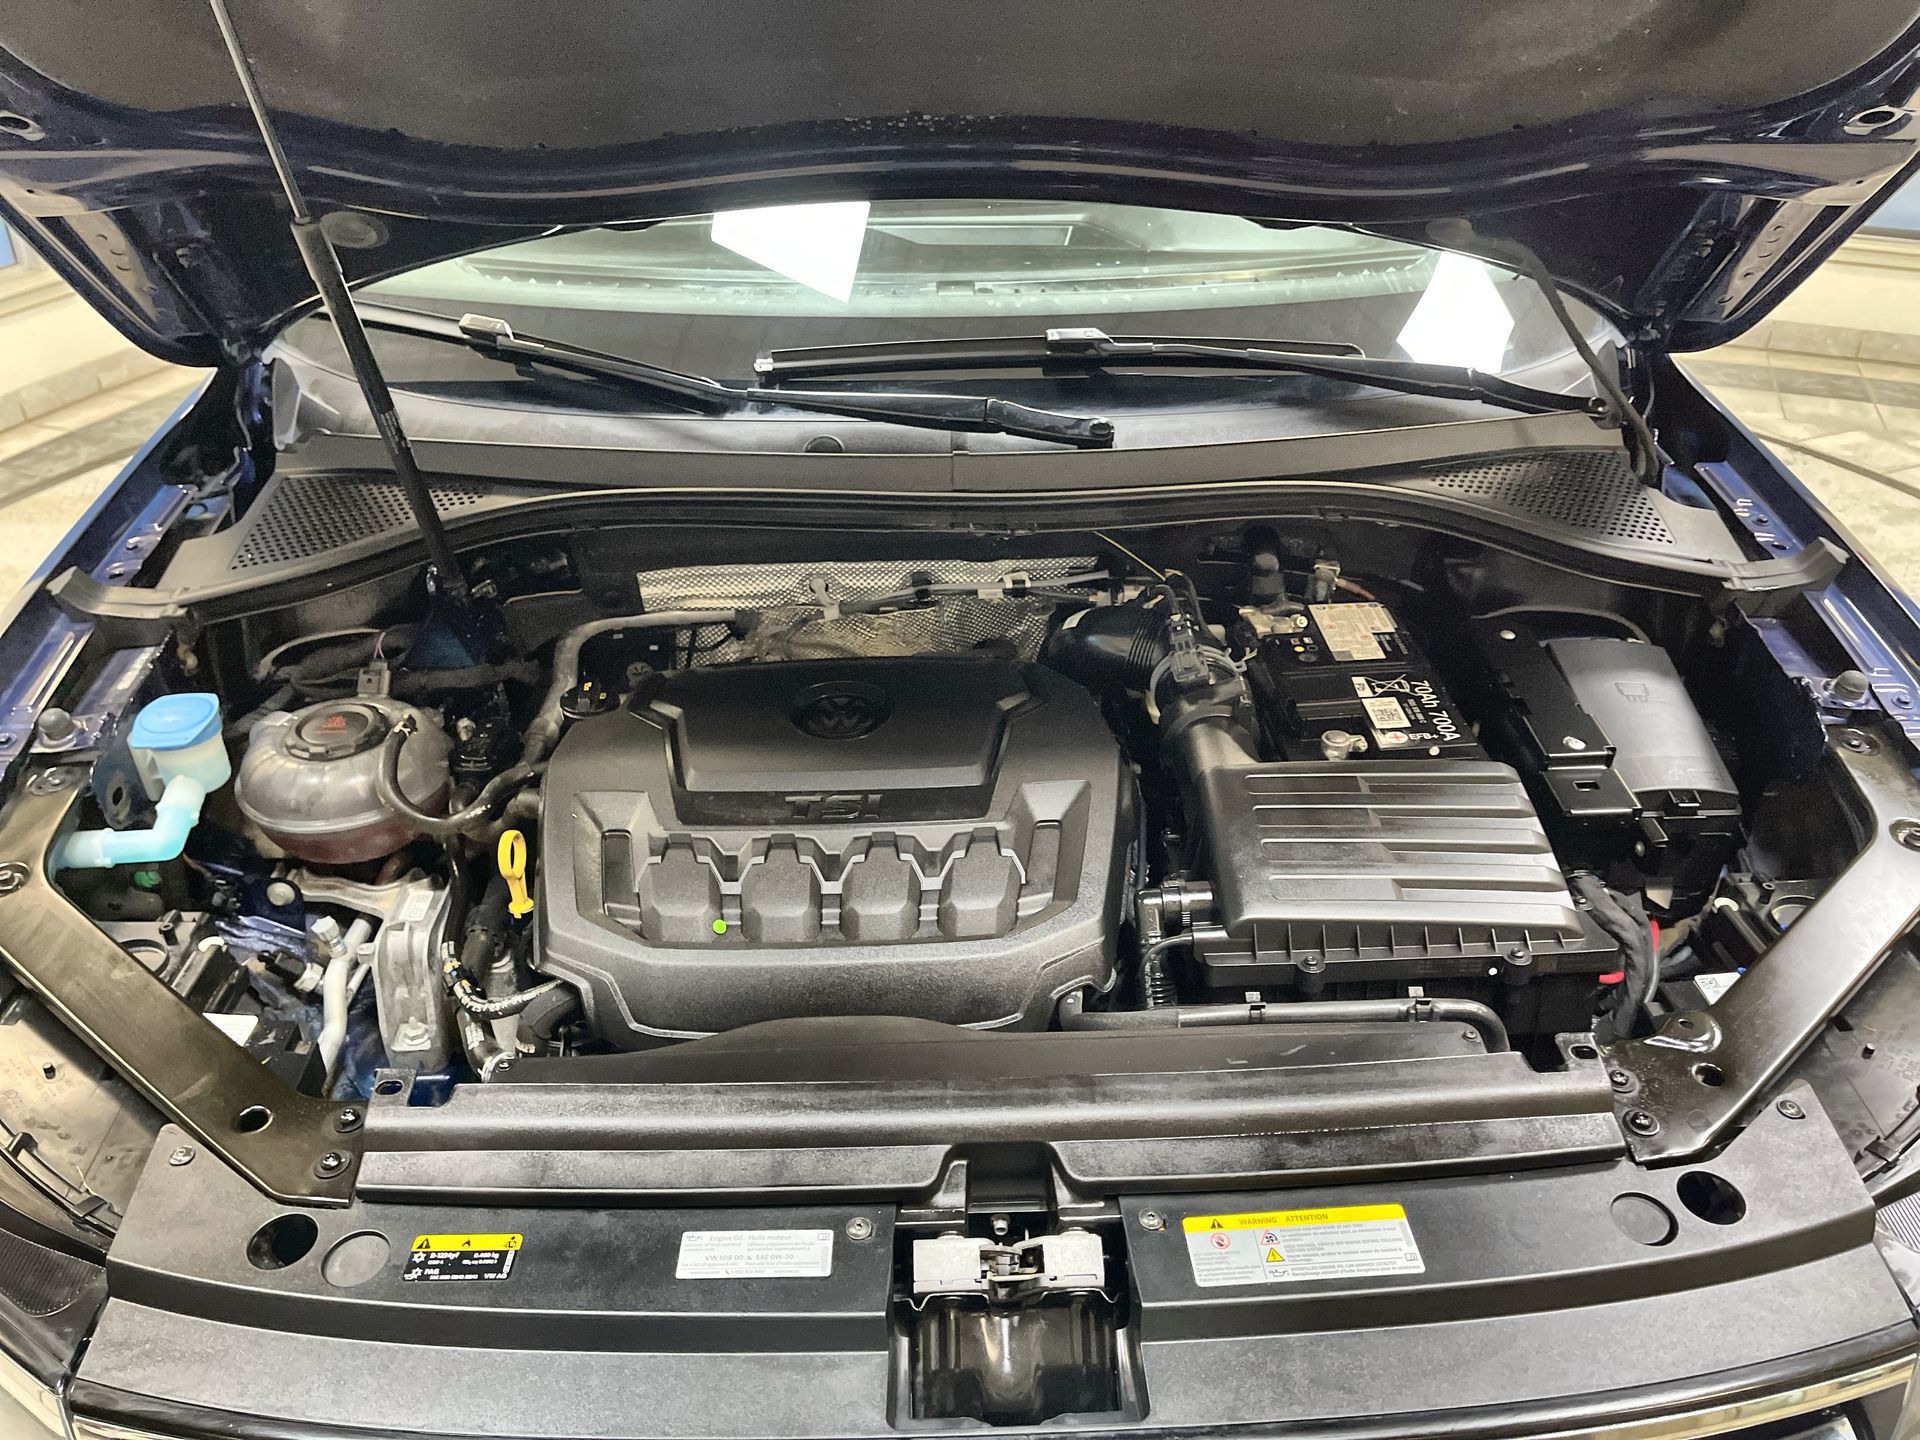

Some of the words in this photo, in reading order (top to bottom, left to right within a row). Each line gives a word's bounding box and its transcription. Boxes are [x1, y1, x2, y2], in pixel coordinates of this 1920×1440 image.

[1410, 680, 1440, 708] 70Ah
[1428, 710, 1461, 742] 700A
[784, 793, 884, 819] TSI
[1239, 1216, 1278, 1226] WARNING
[1285, 1213, 1329, 1223] ATTENTION
